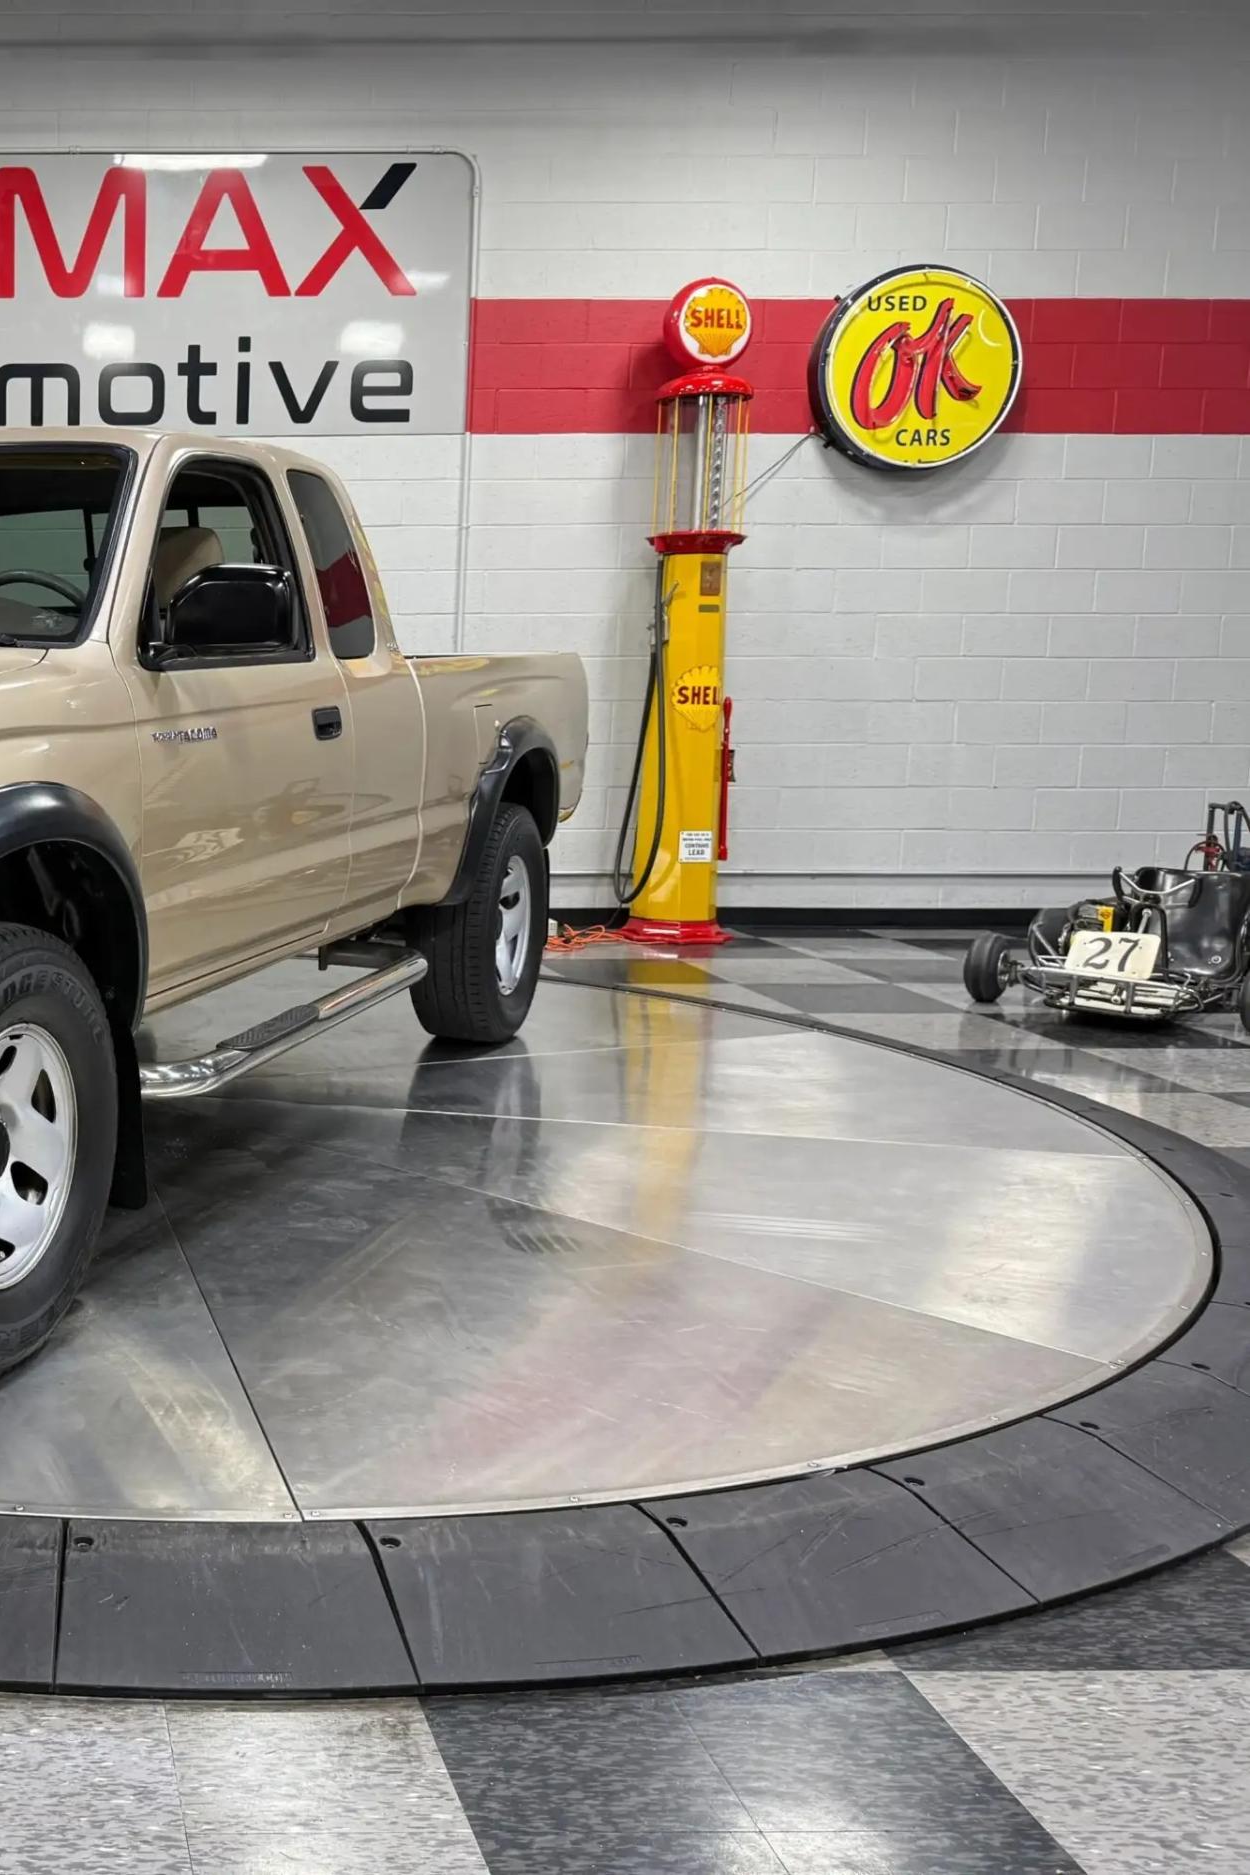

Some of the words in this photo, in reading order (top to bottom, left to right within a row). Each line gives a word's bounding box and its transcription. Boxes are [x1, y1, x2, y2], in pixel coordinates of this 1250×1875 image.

[867, 295, 928, 312] USED
[690, 307, 743, 330] SHELL
[850, 297, 983, 431] OK
[895, 428, 952, 447] CARS
[676, 685, 721, 706] SHEL
[1083, 937, 1141, 973] 27
